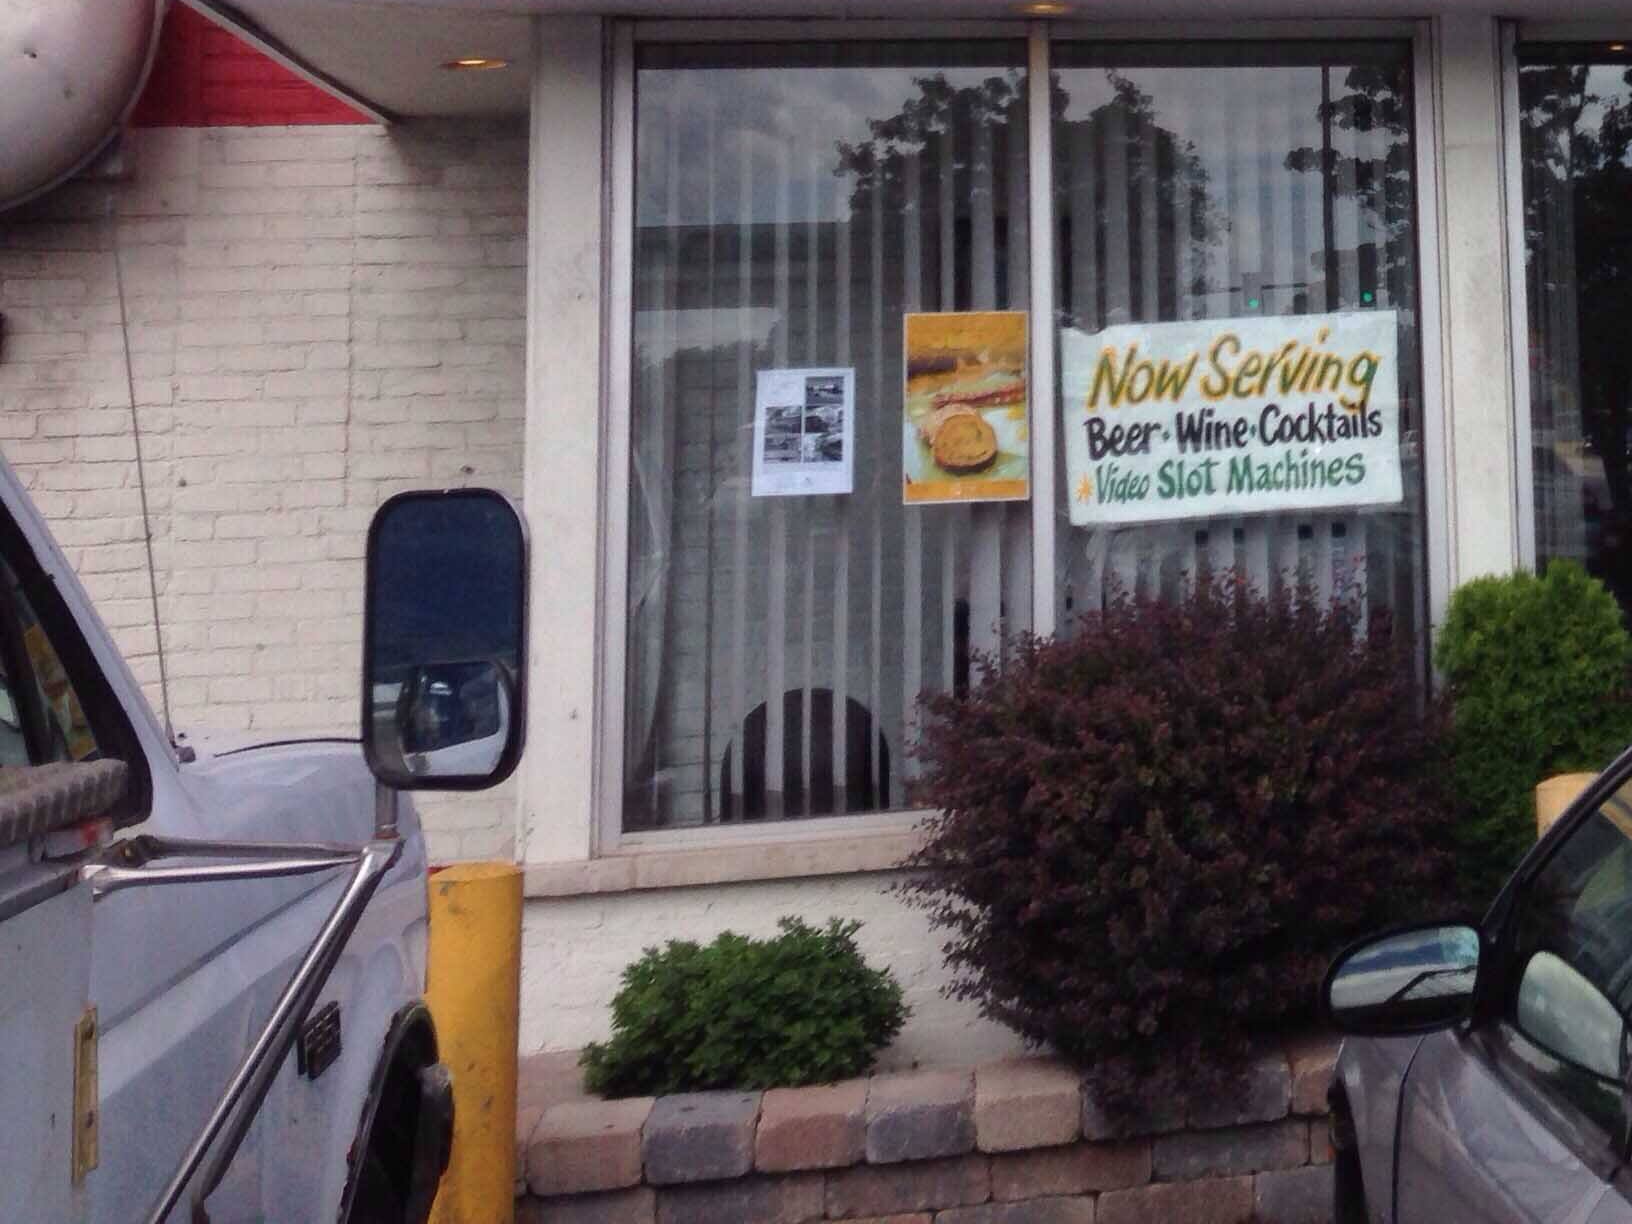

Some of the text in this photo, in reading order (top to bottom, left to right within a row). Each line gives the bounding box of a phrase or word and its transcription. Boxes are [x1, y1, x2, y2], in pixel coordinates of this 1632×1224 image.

[1086, 326, 1382, 413] Now Serving
[1083, 401, 1384, 461] Beer Wine Cocktails
[1094, 447, 1367, 505] Video Slot Machines
